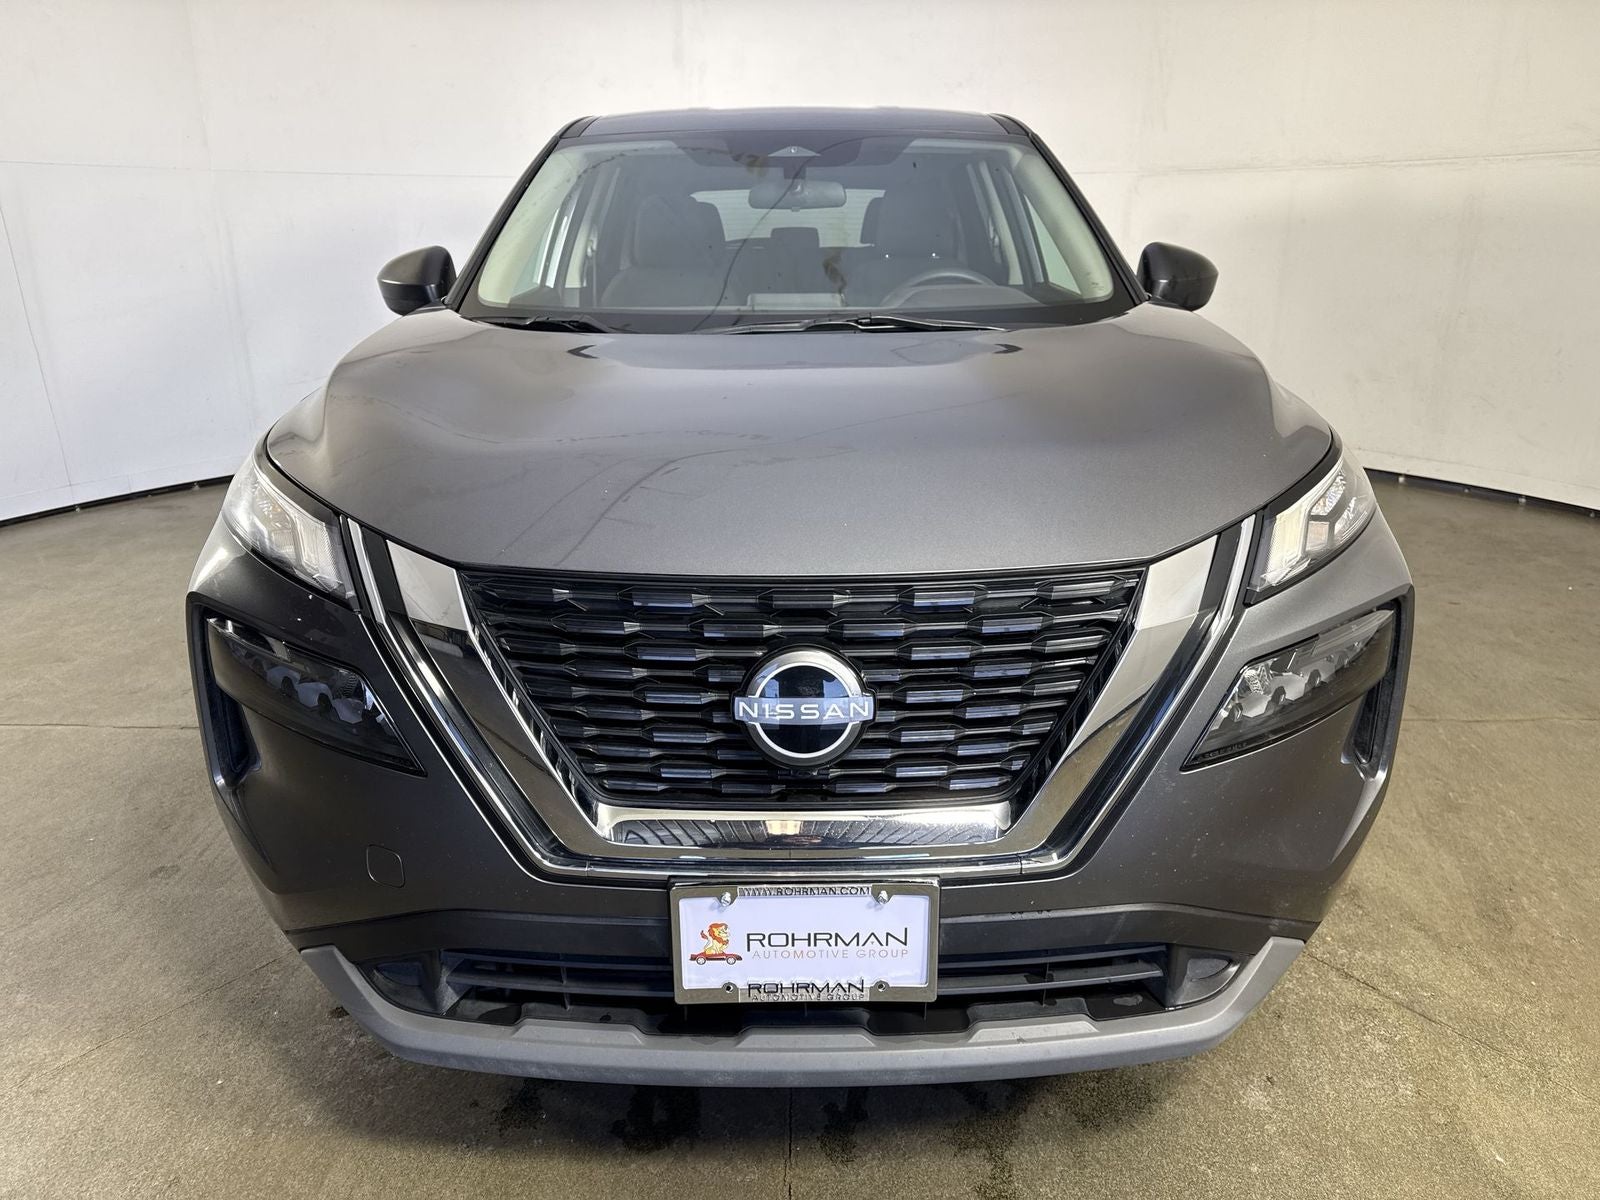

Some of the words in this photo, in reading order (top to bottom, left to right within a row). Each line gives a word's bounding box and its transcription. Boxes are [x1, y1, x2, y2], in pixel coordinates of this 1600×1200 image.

[738, 701, 869, 720] NISSAN
[739, 886, 870, 896] WWW.ROHRMAN.COM
[746, 927, 908, 952] ROHRMAN
[752, 949, 849, 959] AUTOMOTIVE
[856, 949, 909, 959] GROUP
[748, 979, 864, 997] ROHRMAN
[752, 992, 821, 1001] AUTOMOTIVE
[827, 992, 865, 1001] GROUP
